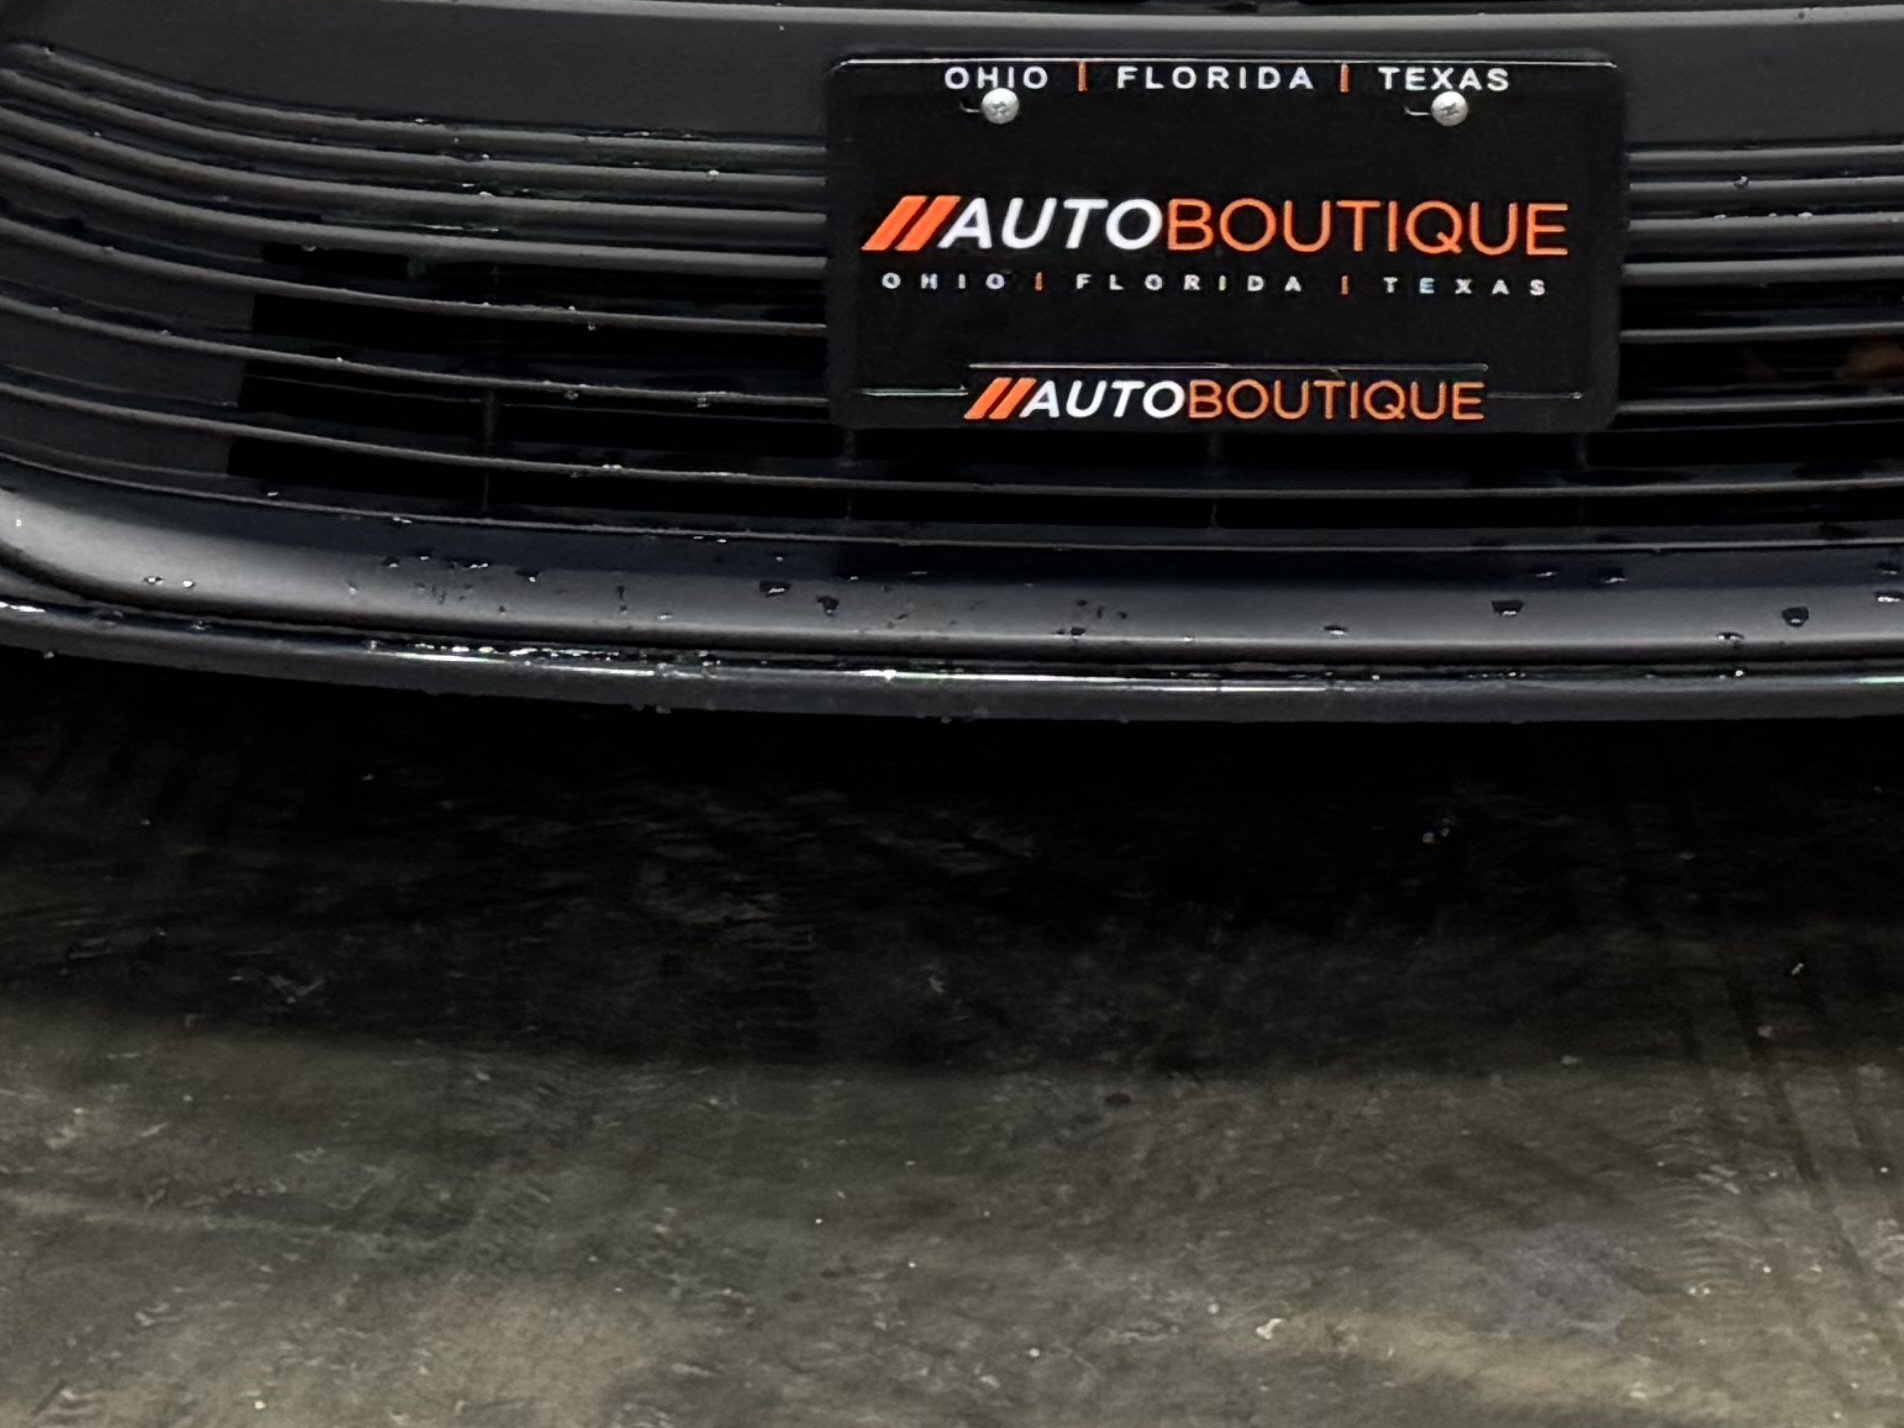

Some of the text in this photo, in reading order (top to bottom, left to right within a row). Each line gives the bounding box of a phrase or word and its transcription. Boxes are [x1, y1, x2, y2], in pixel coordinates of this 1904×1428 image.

[943, 64, 1509, 94] OHIO FLORIDA TEXAS
[939, 194, 1569, 256] AUTOBOUTIQUE
[880, 271, 1546, 296] OHIO FLORIDA TEXAS
[1016, 377, 1485, 421] AUTOBOUTIQUE
